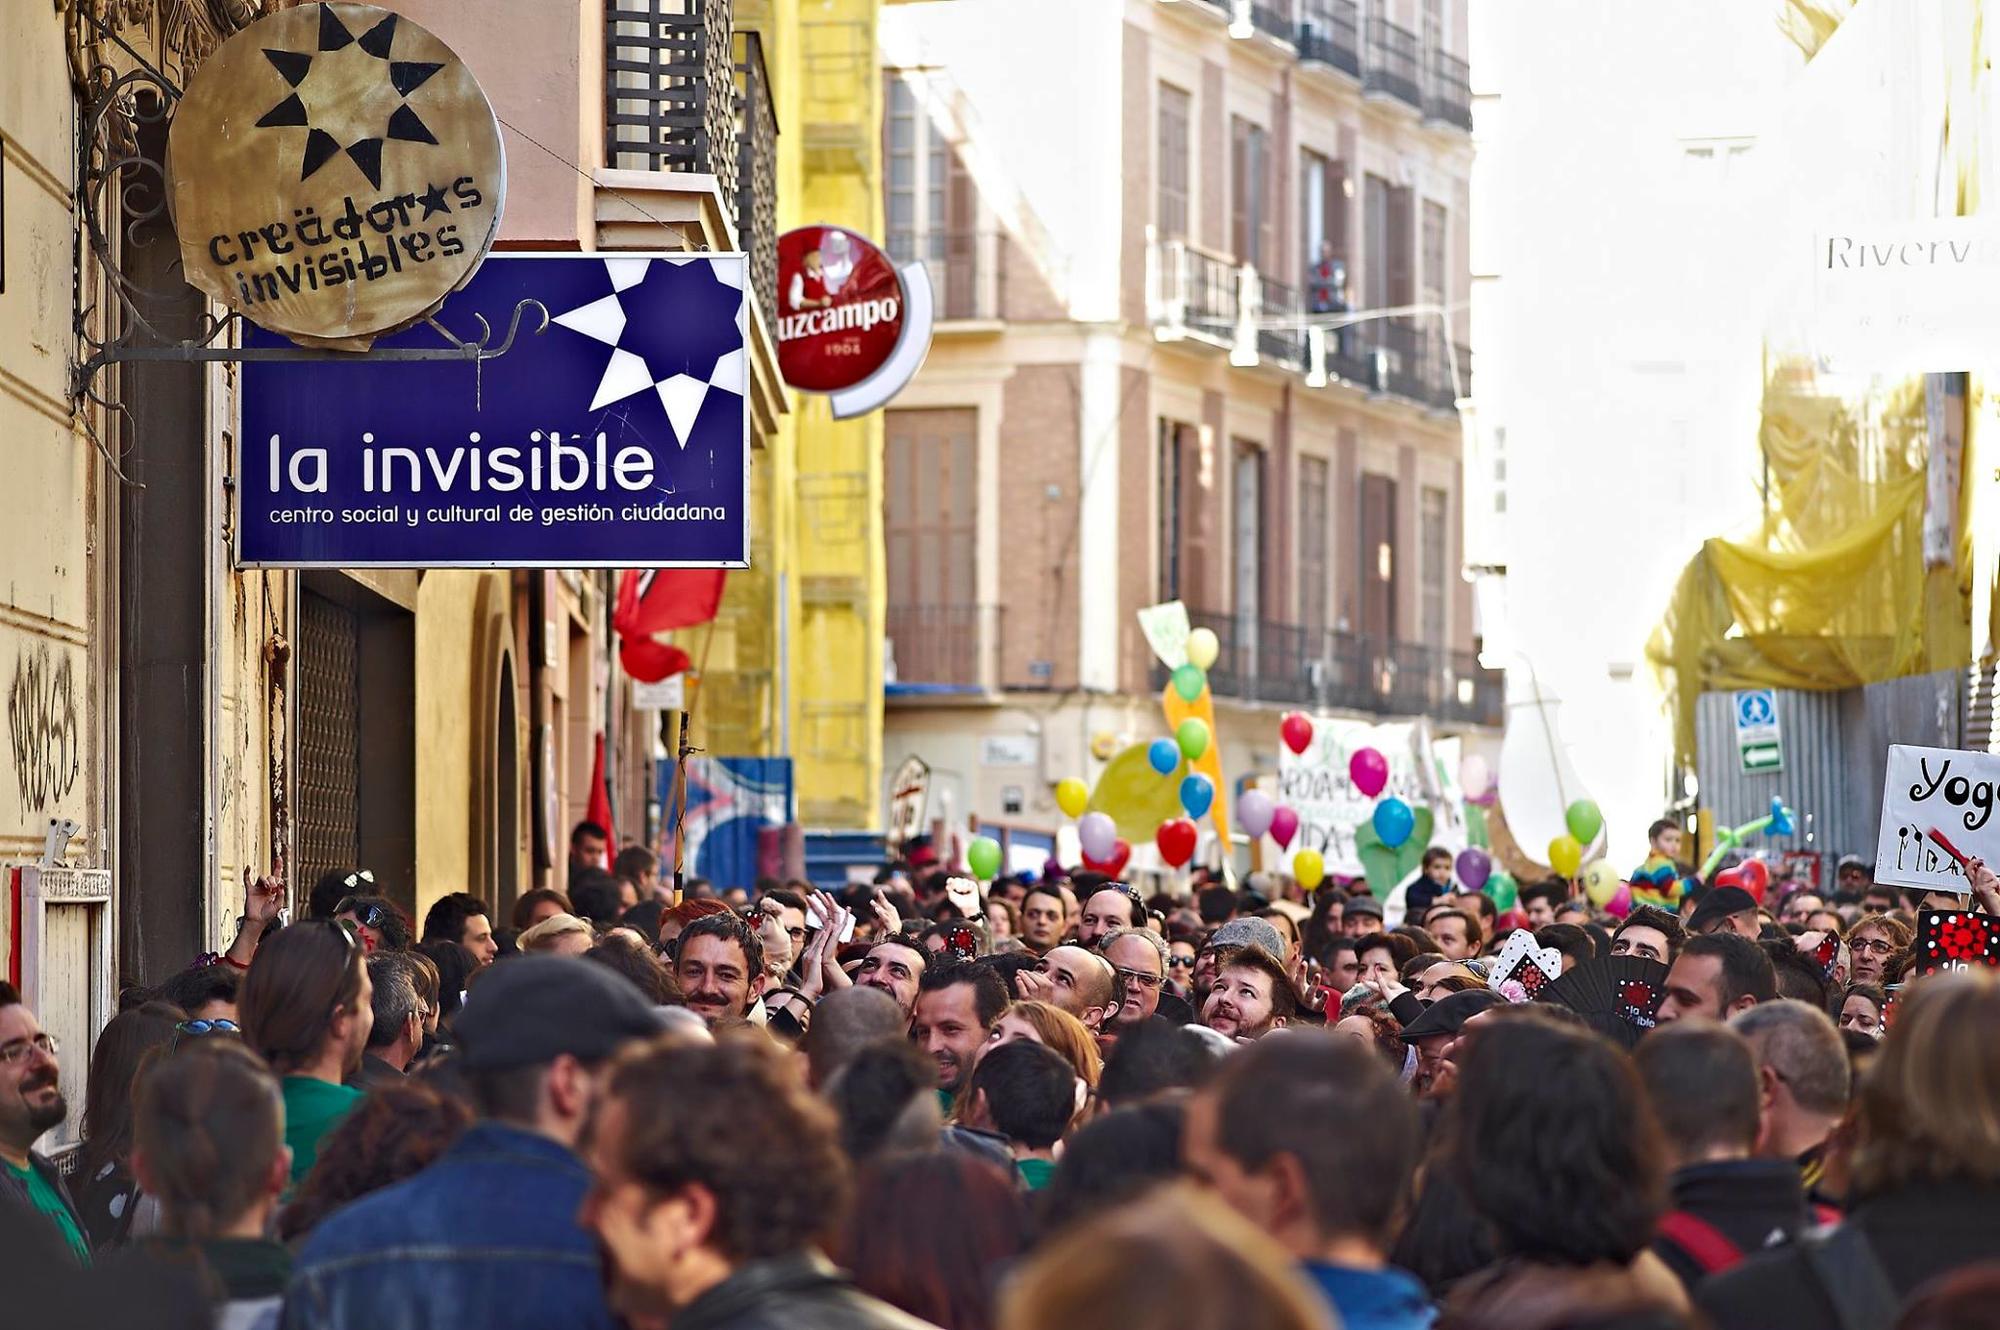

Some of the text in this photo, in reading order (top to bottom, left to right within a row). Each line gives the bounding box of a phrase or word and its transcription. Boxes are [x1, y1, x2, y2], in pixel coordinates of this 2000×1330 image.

[237, 225, 464, 305] invisibles
[1827, 237, 1972, 269] Riverv
[778, 298, 896, 341] uzcampo
[269, 431, 655, 493] la invisible
[269, 504, 726, 527] centro social y cultural de gestión ciudadana
